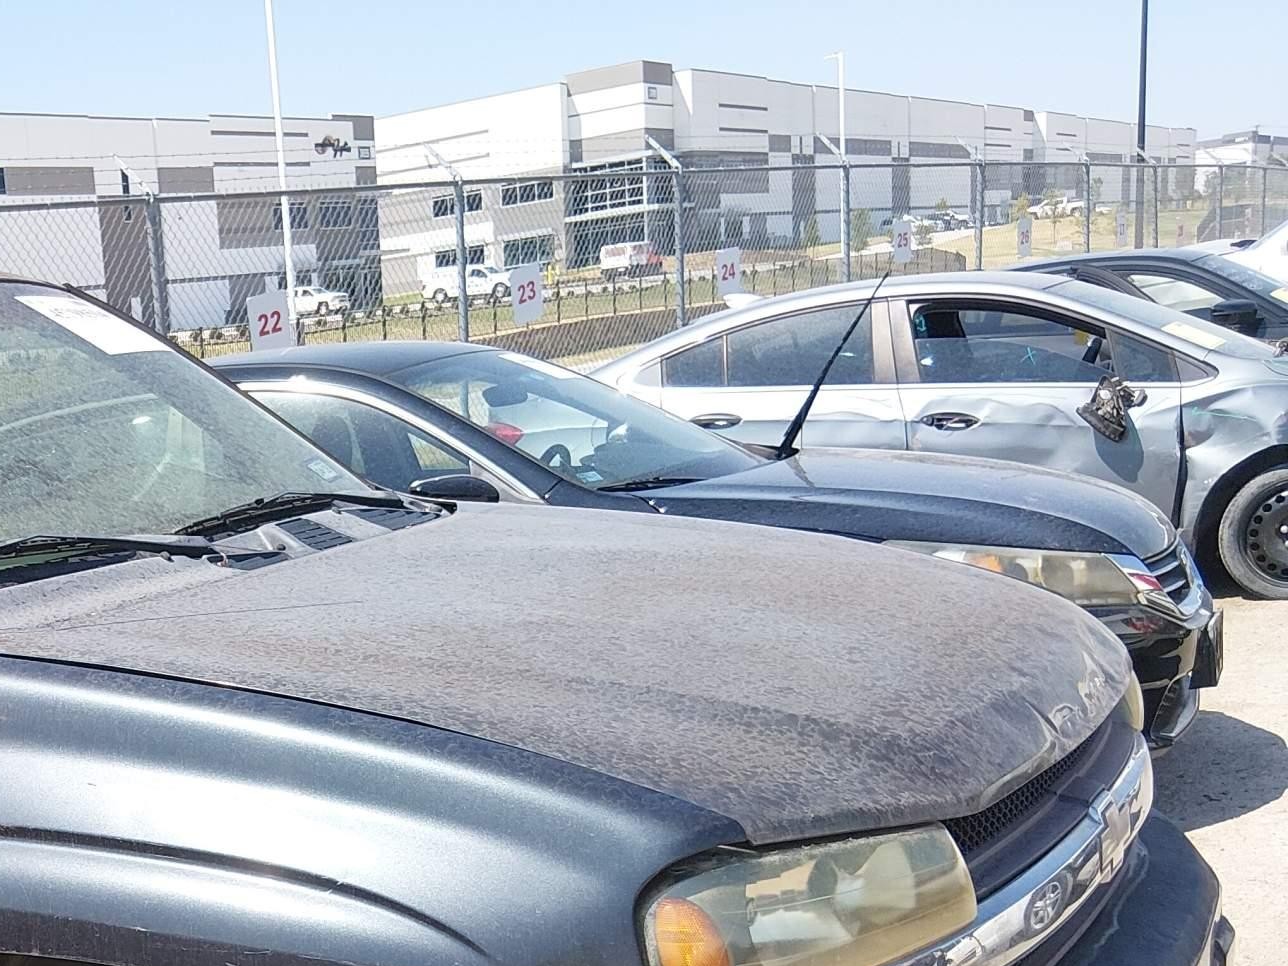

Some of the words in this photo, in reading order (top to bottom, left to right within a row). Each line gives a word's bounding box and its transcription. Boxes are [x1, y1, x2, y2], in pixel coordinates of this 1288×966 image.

[897, 232, 909, 248] 25
[721, 262, 736, 281] 24
[517, 281, 536, 304] 23
[257, 310, 282, 337] 22
